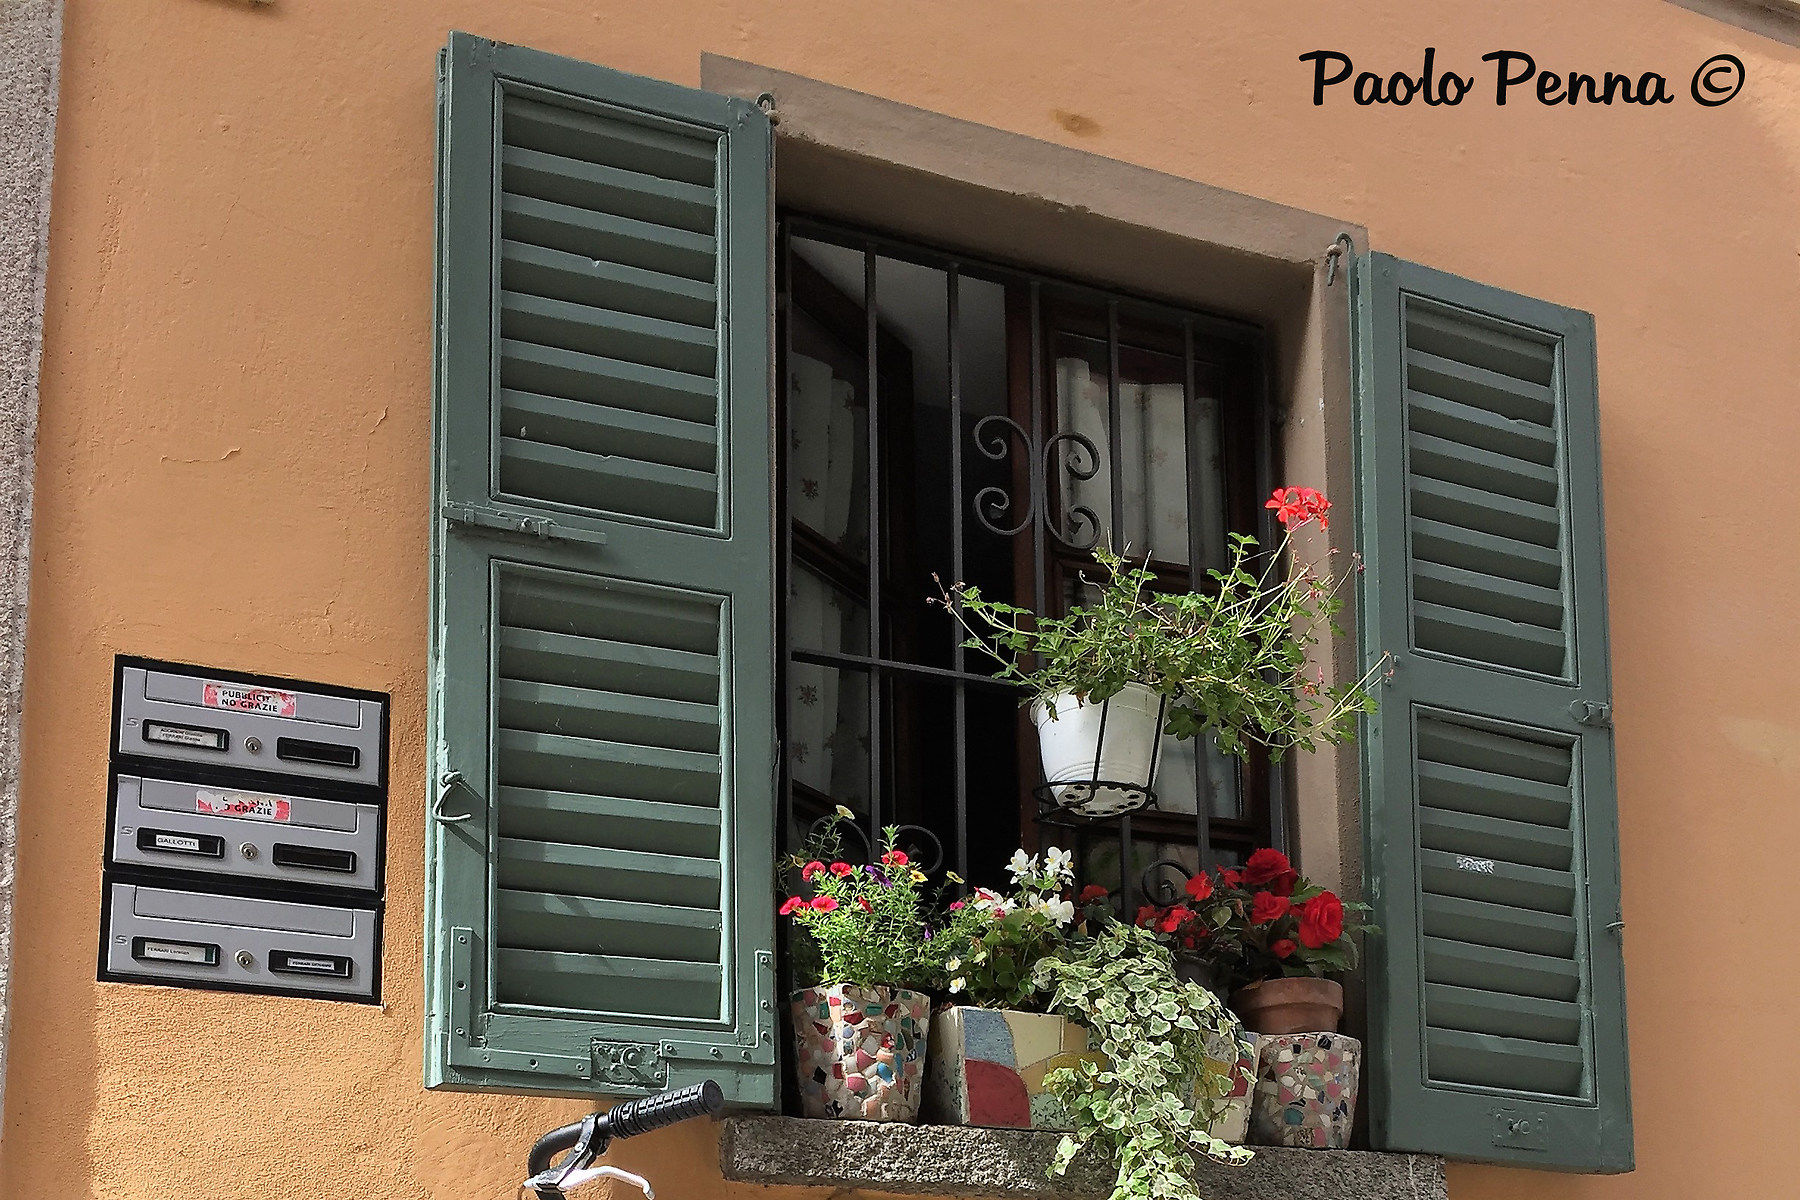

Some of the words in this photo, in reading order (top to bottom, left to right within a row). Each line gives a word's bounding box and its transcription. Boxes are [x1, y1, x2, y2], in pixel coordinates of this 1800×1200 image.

[221, 698, 236, 707] NO
[240, 700, 278, 713] GRAZIE
[234, 804, 273, 816] GRAZIE
[157, 837, 196, 847] GALLOTTI
